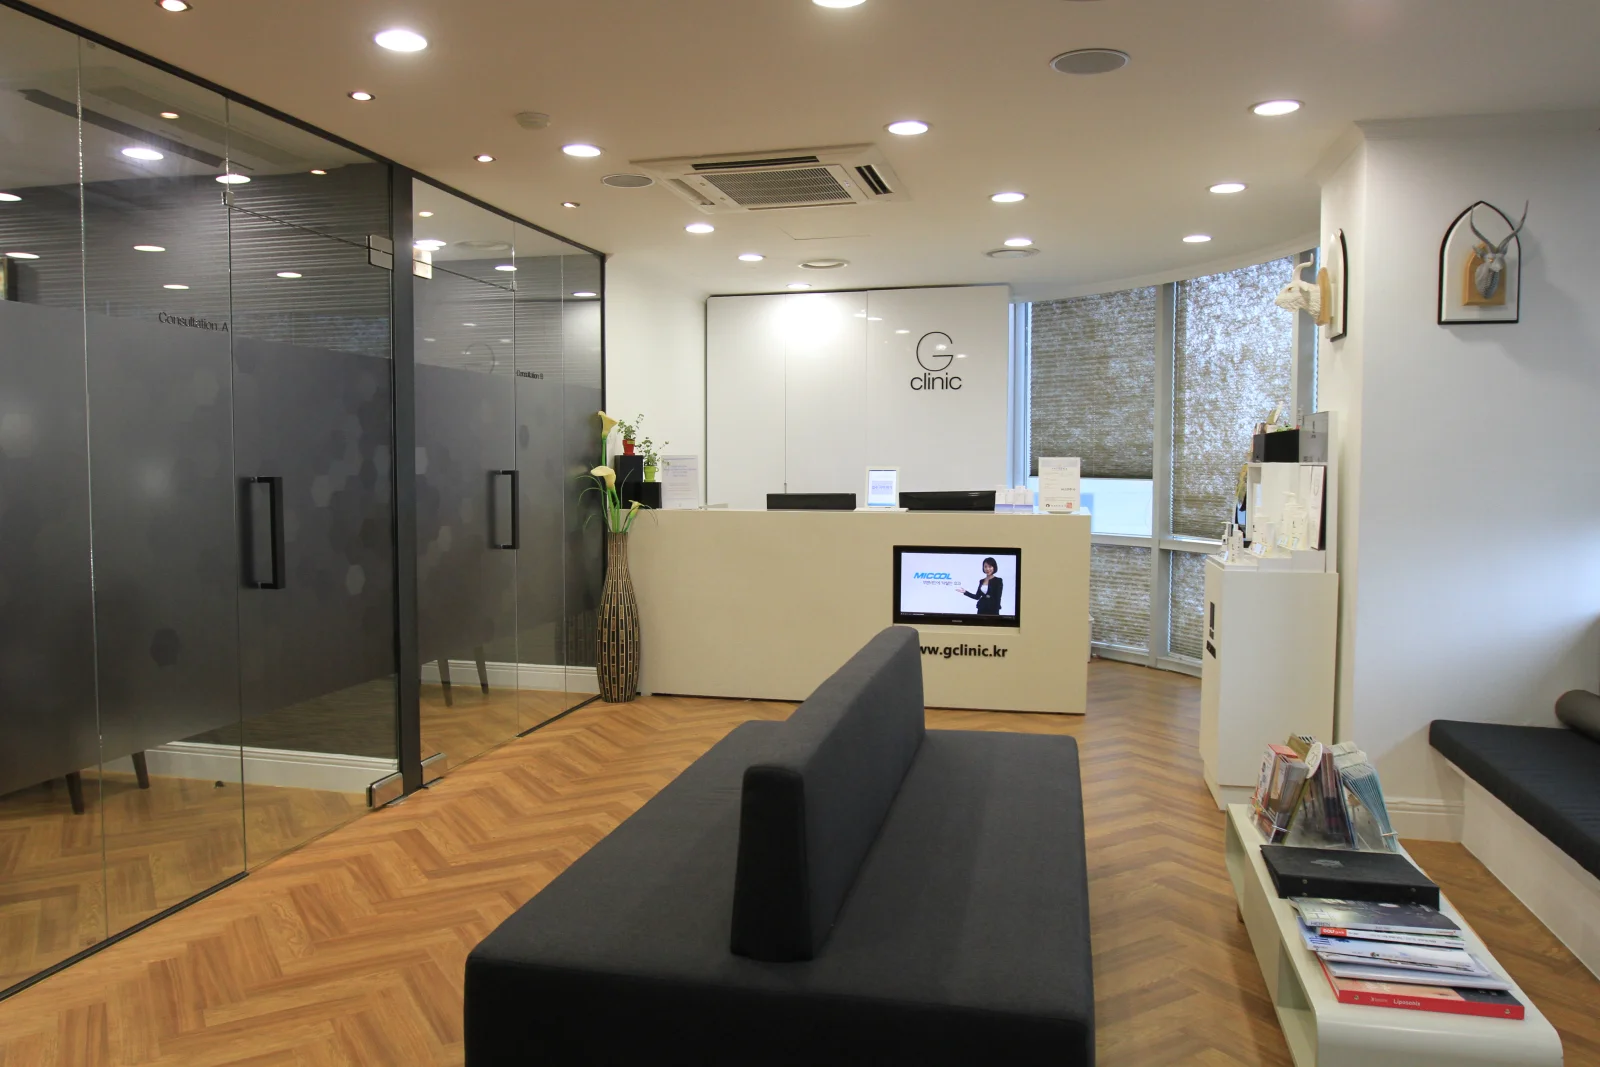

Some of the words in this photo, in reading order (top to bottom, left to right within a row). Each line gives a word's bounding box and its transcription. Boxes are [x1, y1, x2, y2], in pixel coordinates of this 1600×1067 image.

[158, 311, 218, 331] Consultation
[221, 321, 229, 332] A
[916, 331, 954, 372] G
[910, 372, 962, 390] clinic
